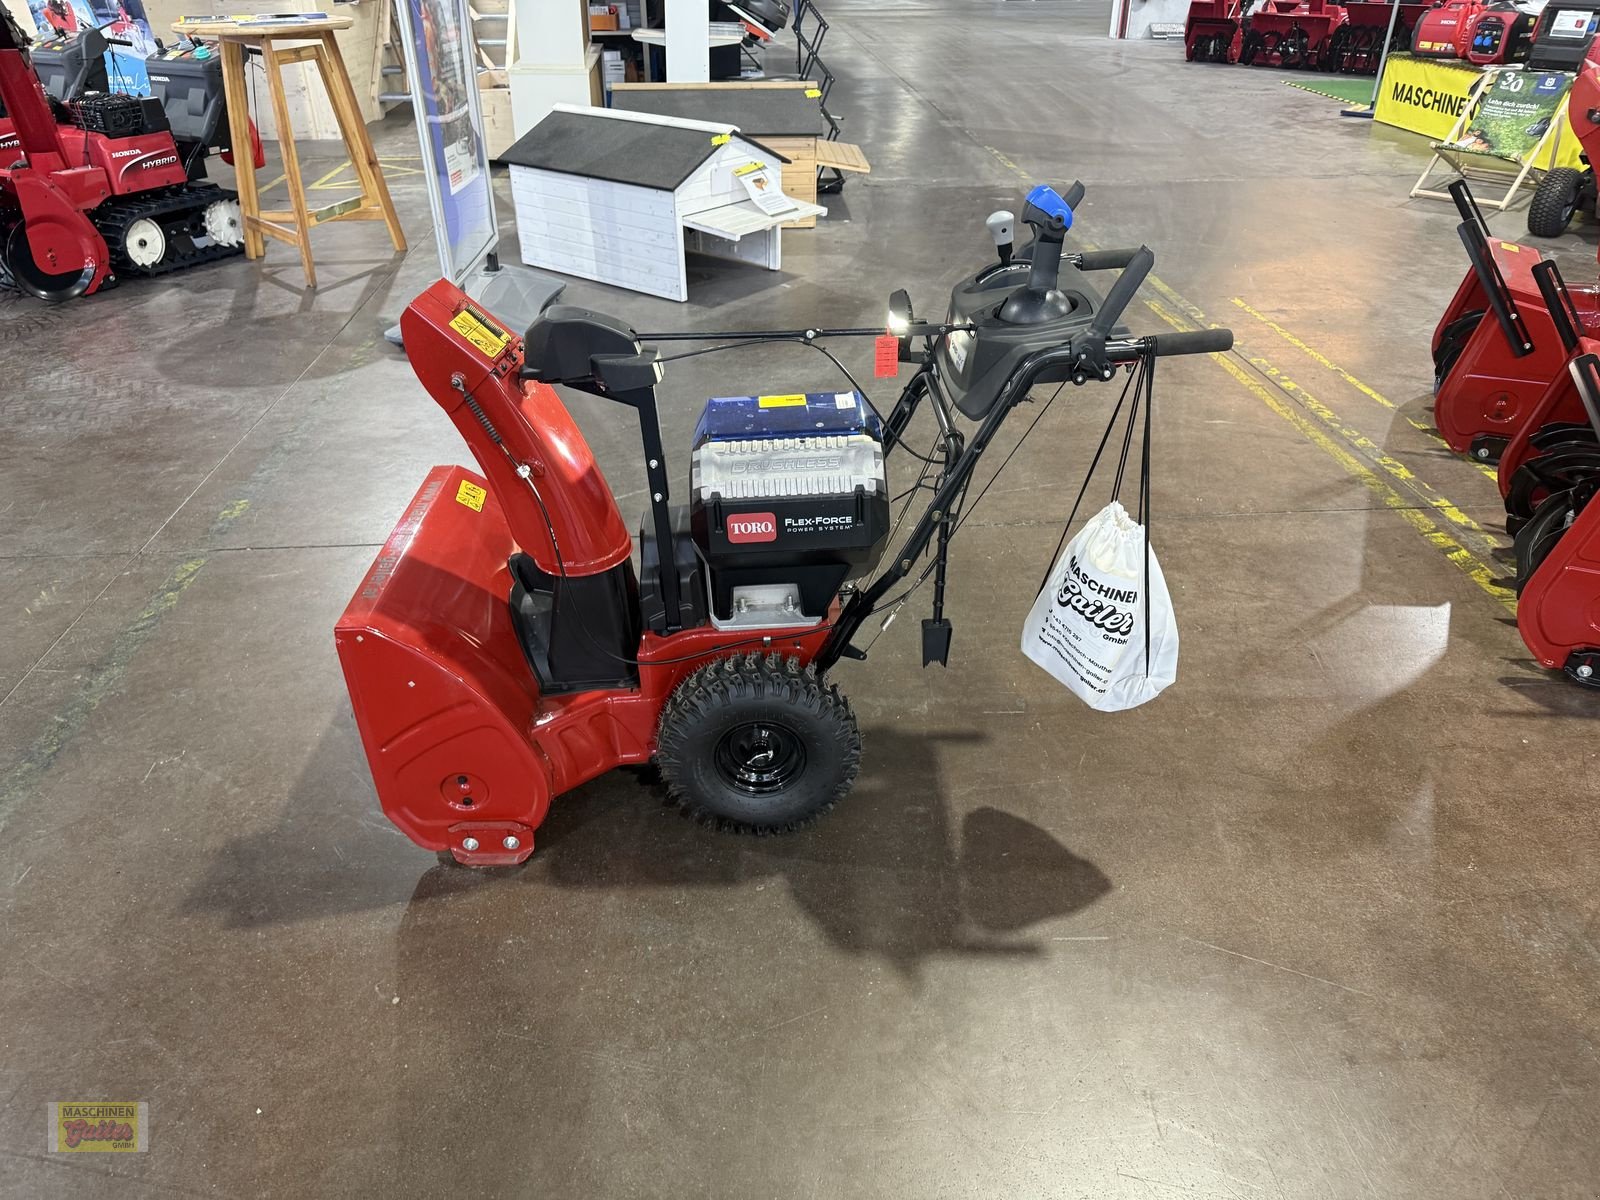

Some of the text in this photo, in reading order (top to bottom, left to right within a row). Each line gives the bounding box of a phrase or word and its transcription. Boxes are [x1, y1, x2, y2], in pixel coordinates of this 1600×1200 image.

[0, 139, 20, 149] HYB
[111, 149, 142, 159] HONDA
[142, 155, 177, 169] HYBRID
[731, 456, 841, 475] BRUSHLESS
[1058, 571, 1134, 636] Gailer
[1102, 633, 1128, 645] GmbH
